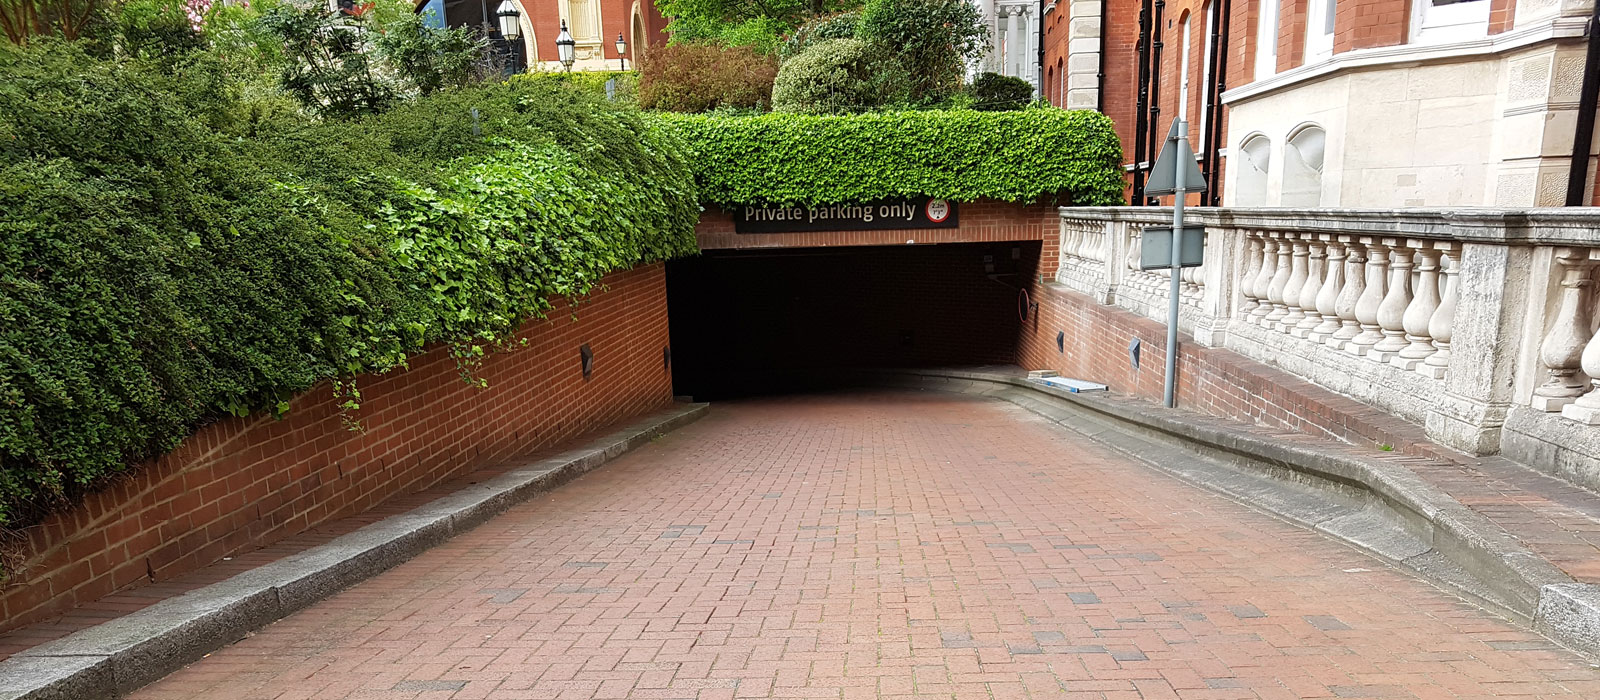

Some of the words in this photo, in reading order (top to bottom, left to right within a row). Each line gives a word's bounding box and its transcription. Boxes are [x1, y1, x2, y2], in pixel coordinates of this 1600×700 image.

[745, 204, 802, 221] Private
[809, 203, 873, 223] parking
[879, 201, 916, 221] only
